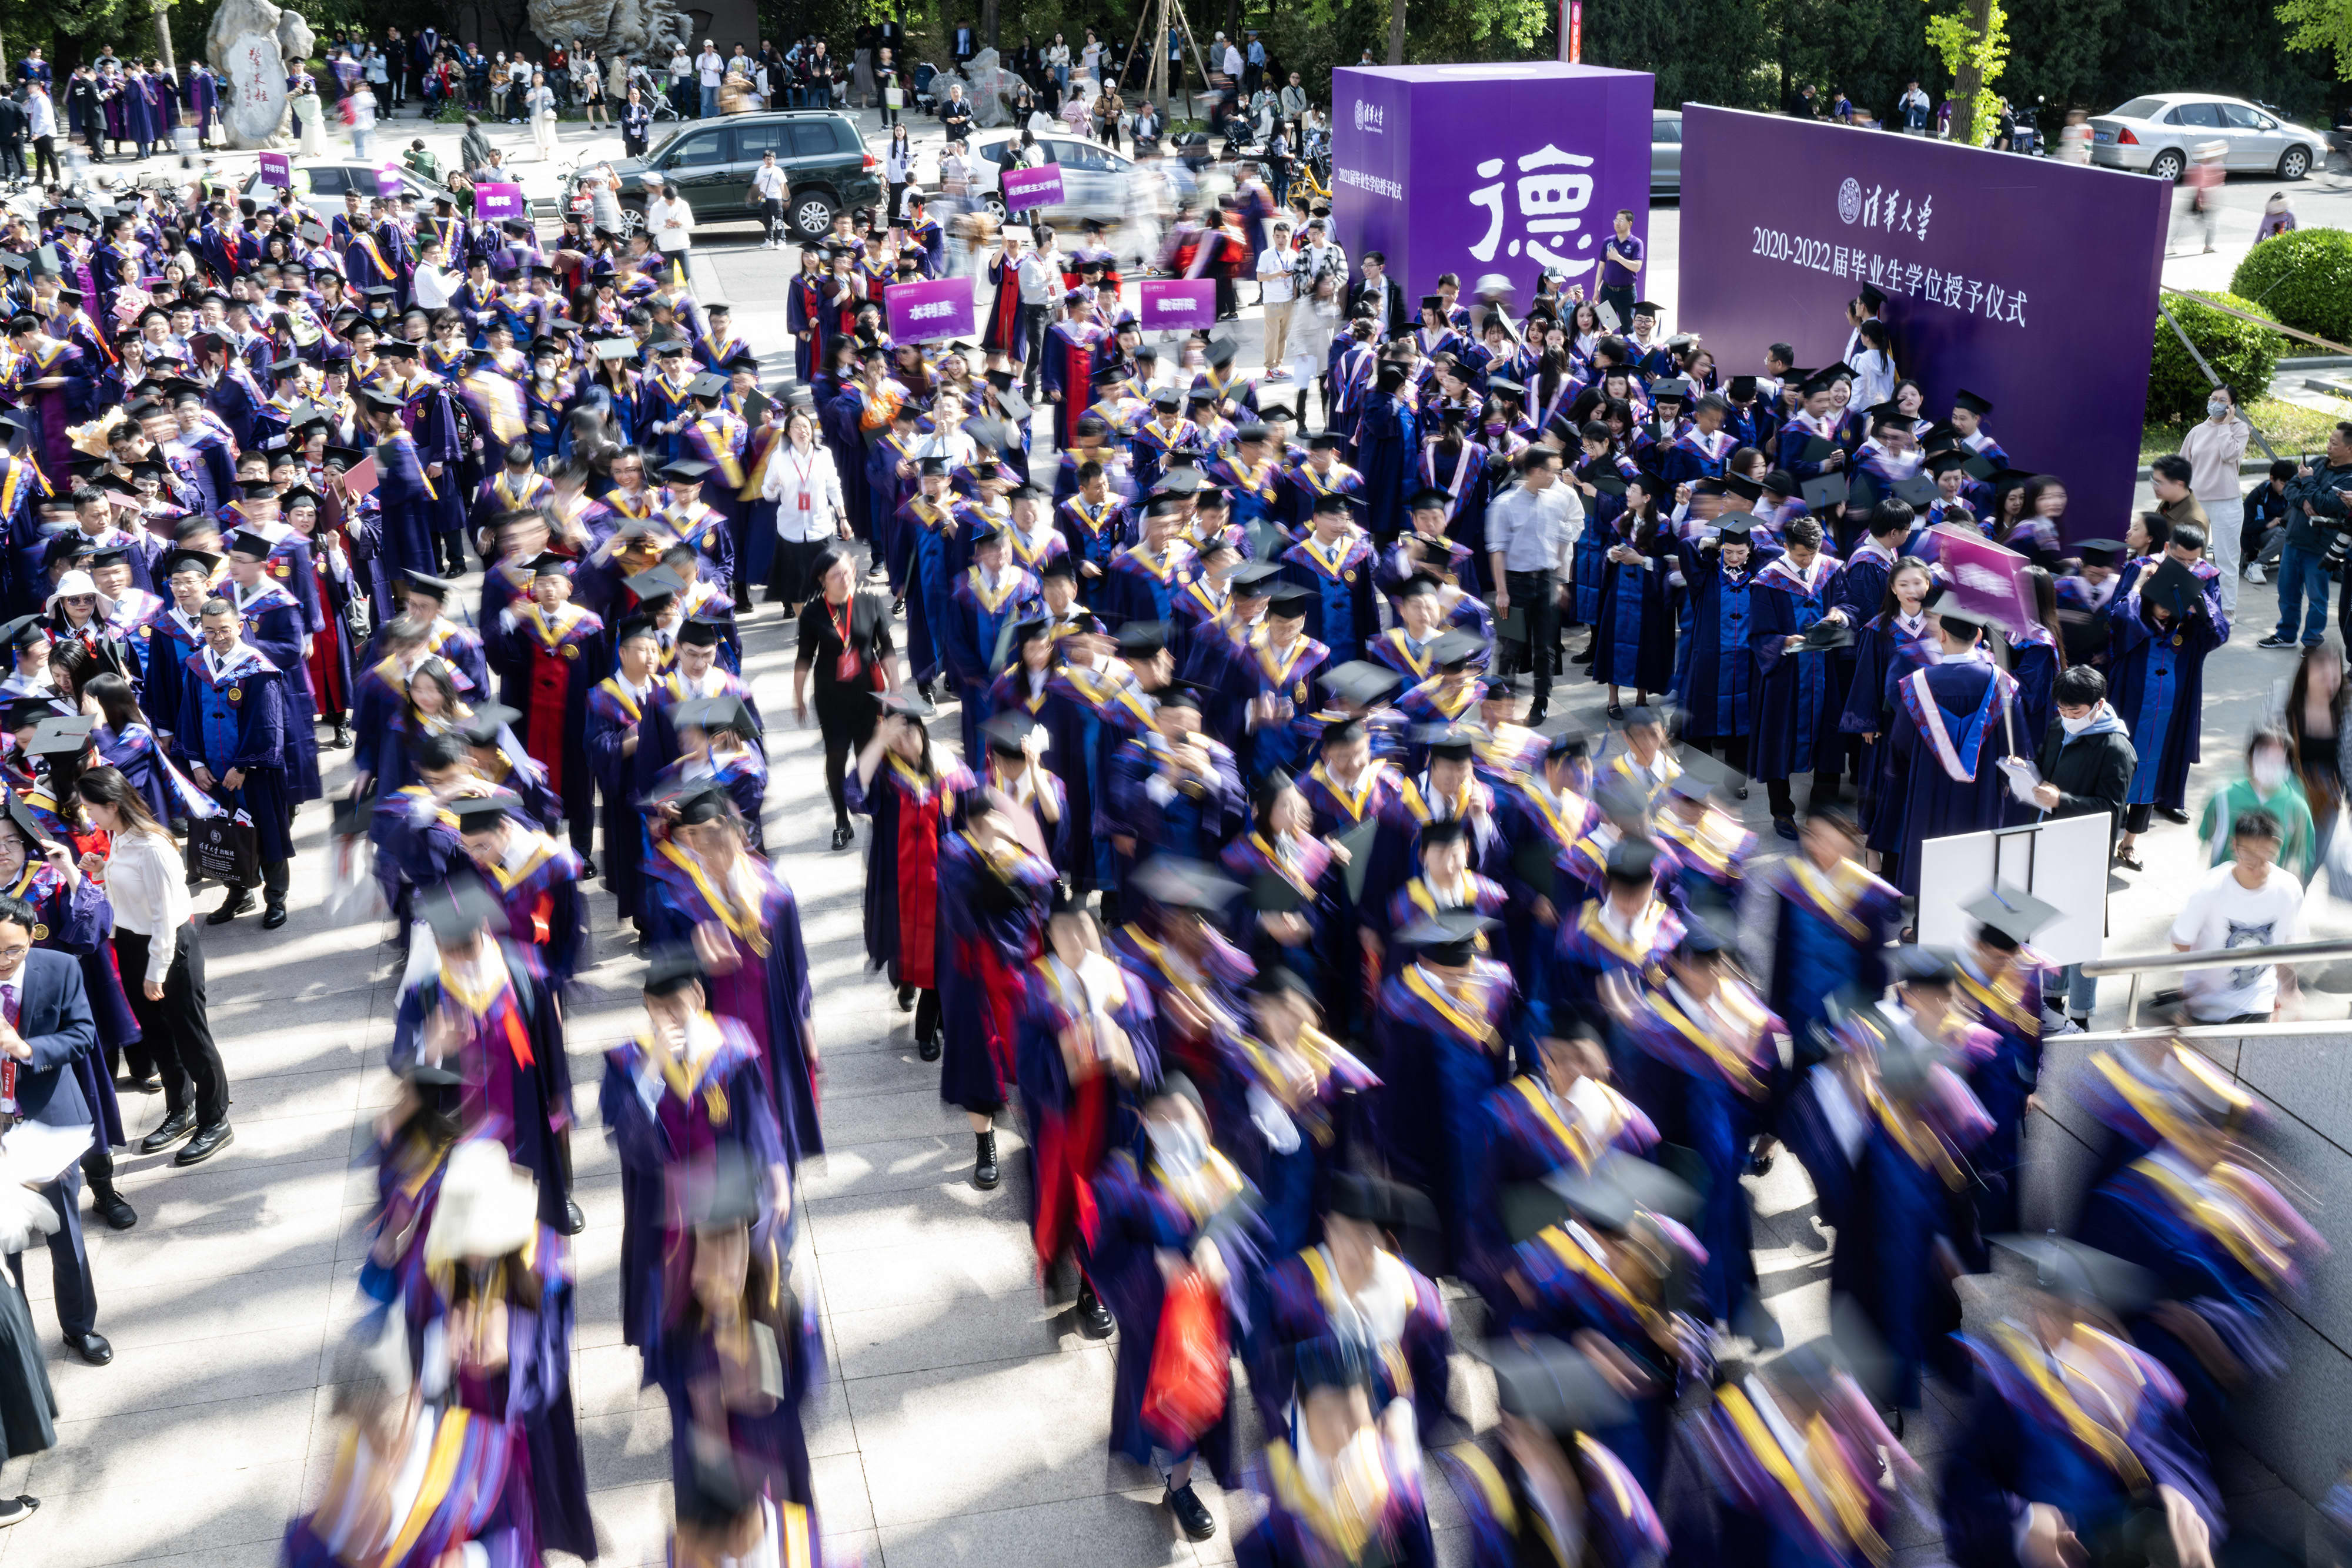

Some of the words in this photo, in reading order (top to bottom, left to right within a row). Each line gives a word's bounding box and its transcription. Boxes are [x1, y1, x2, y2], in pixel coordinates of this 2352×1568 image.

[264, 163, 285, 175] 环境学院
[1338, 168, 1402, 201] 2021届毕业生学位授予仪式
[1752, 226, 2028, 327] 2020-2022届毕业生学位授予仪式
[908, 300, 958, 320] 水利系
